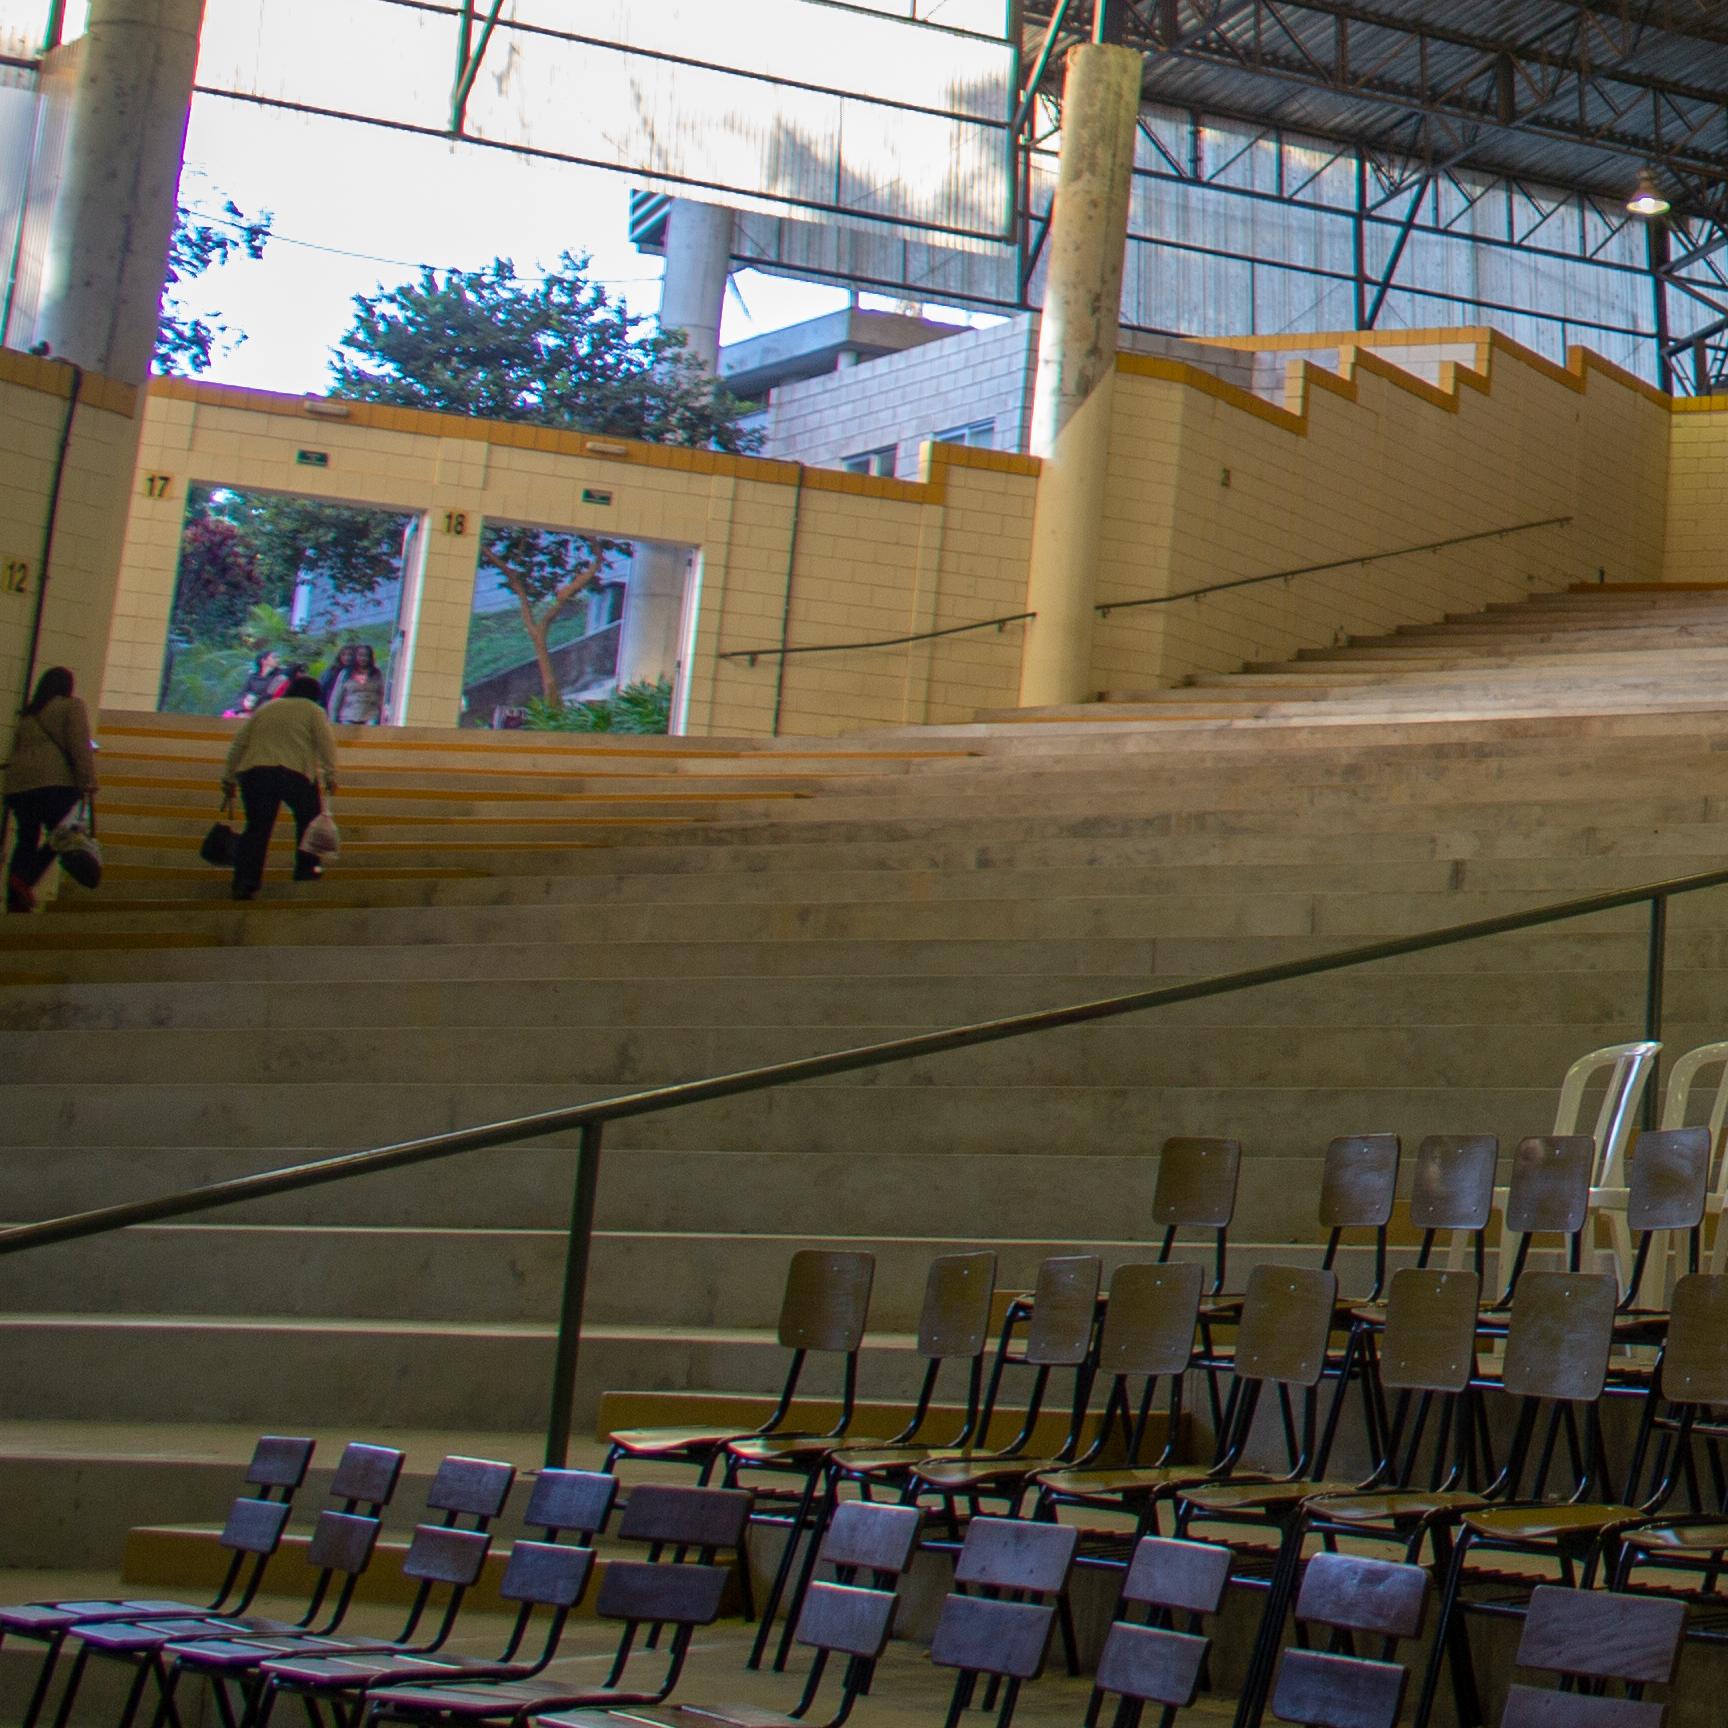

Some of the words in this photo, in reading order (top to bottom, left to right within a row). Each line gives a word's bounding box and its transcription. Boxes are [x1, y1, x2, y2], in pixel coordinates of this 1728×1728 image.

[147, 475, 171, 497] 17
[445, 512, 465, 535] 18
[8, 561, 27, 592] 12
